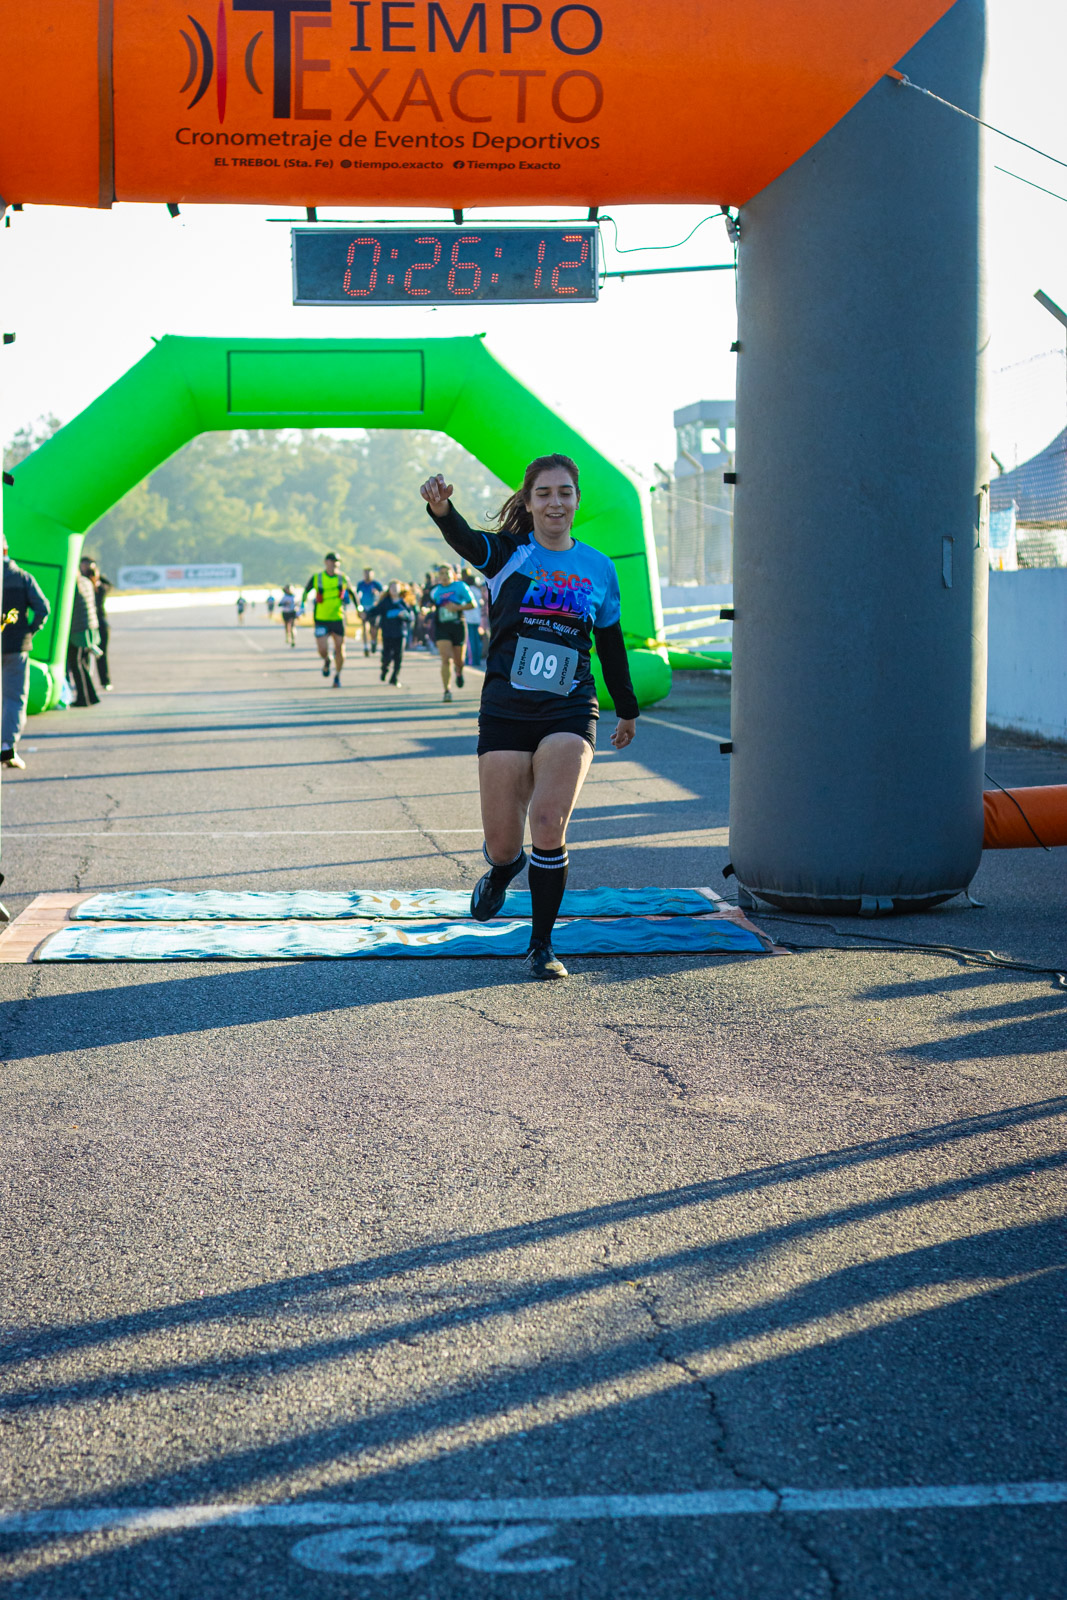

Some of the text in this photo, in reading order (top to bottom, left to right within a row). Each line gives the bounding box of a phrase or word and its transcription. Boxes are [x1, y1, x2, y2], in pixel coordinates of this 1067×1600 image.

[294, 16, 604, 124] EXACTO
[175, 127, 600, 152] Cronometraje de Eventos Deportivos
[214, 158, 334, 169] EL TREBOL (Sta. Fe)
[354, 160, 444, 171] tiempo.exacto
[467, 160, 561, 171] Tiempo Exacto
[530, 651, 558, 680] 09
